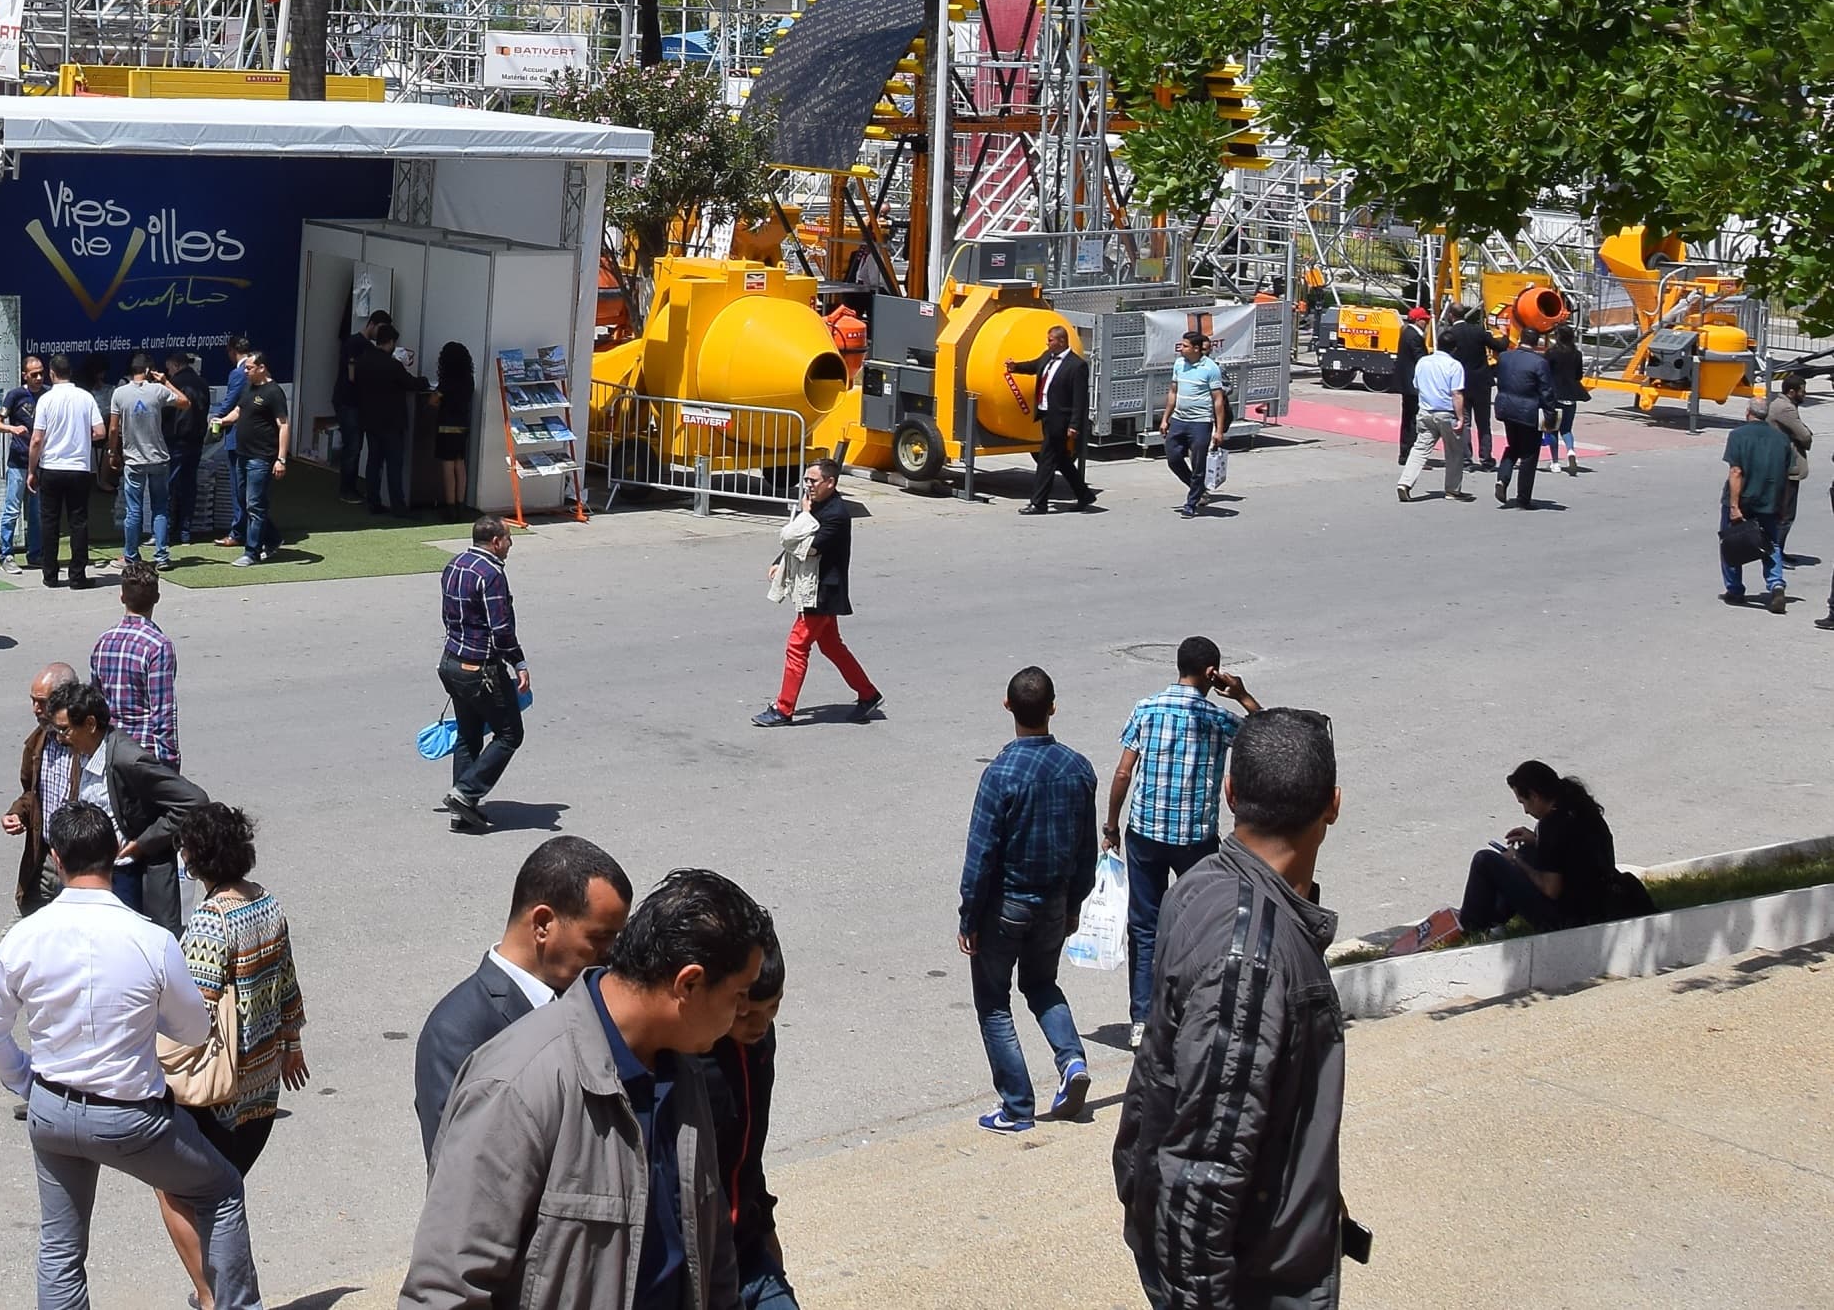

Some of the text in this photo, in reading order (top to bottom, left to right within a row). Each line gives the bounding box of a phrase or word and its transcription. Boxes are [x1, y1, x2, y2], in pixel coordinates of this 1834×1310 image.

[514, 46, 576, 55] BATIVERT
[44, 179, 131, 227] Vies
[71, 224, 112, 257] de
[26, 339, 39, 354] Un
[40, 340, 93, 356] engagement,
[94, 337, 109, 352] des
[110, 336, 131, 351] idées
[141, 336, 150, 350] et
[150, 337, 166, 349] une
[165, 333, 185, 350] force
[186, 333, 197, 348] de
[197, 331, 232, 350] propositi
[682, 414, 729, 428] BATIVERT
